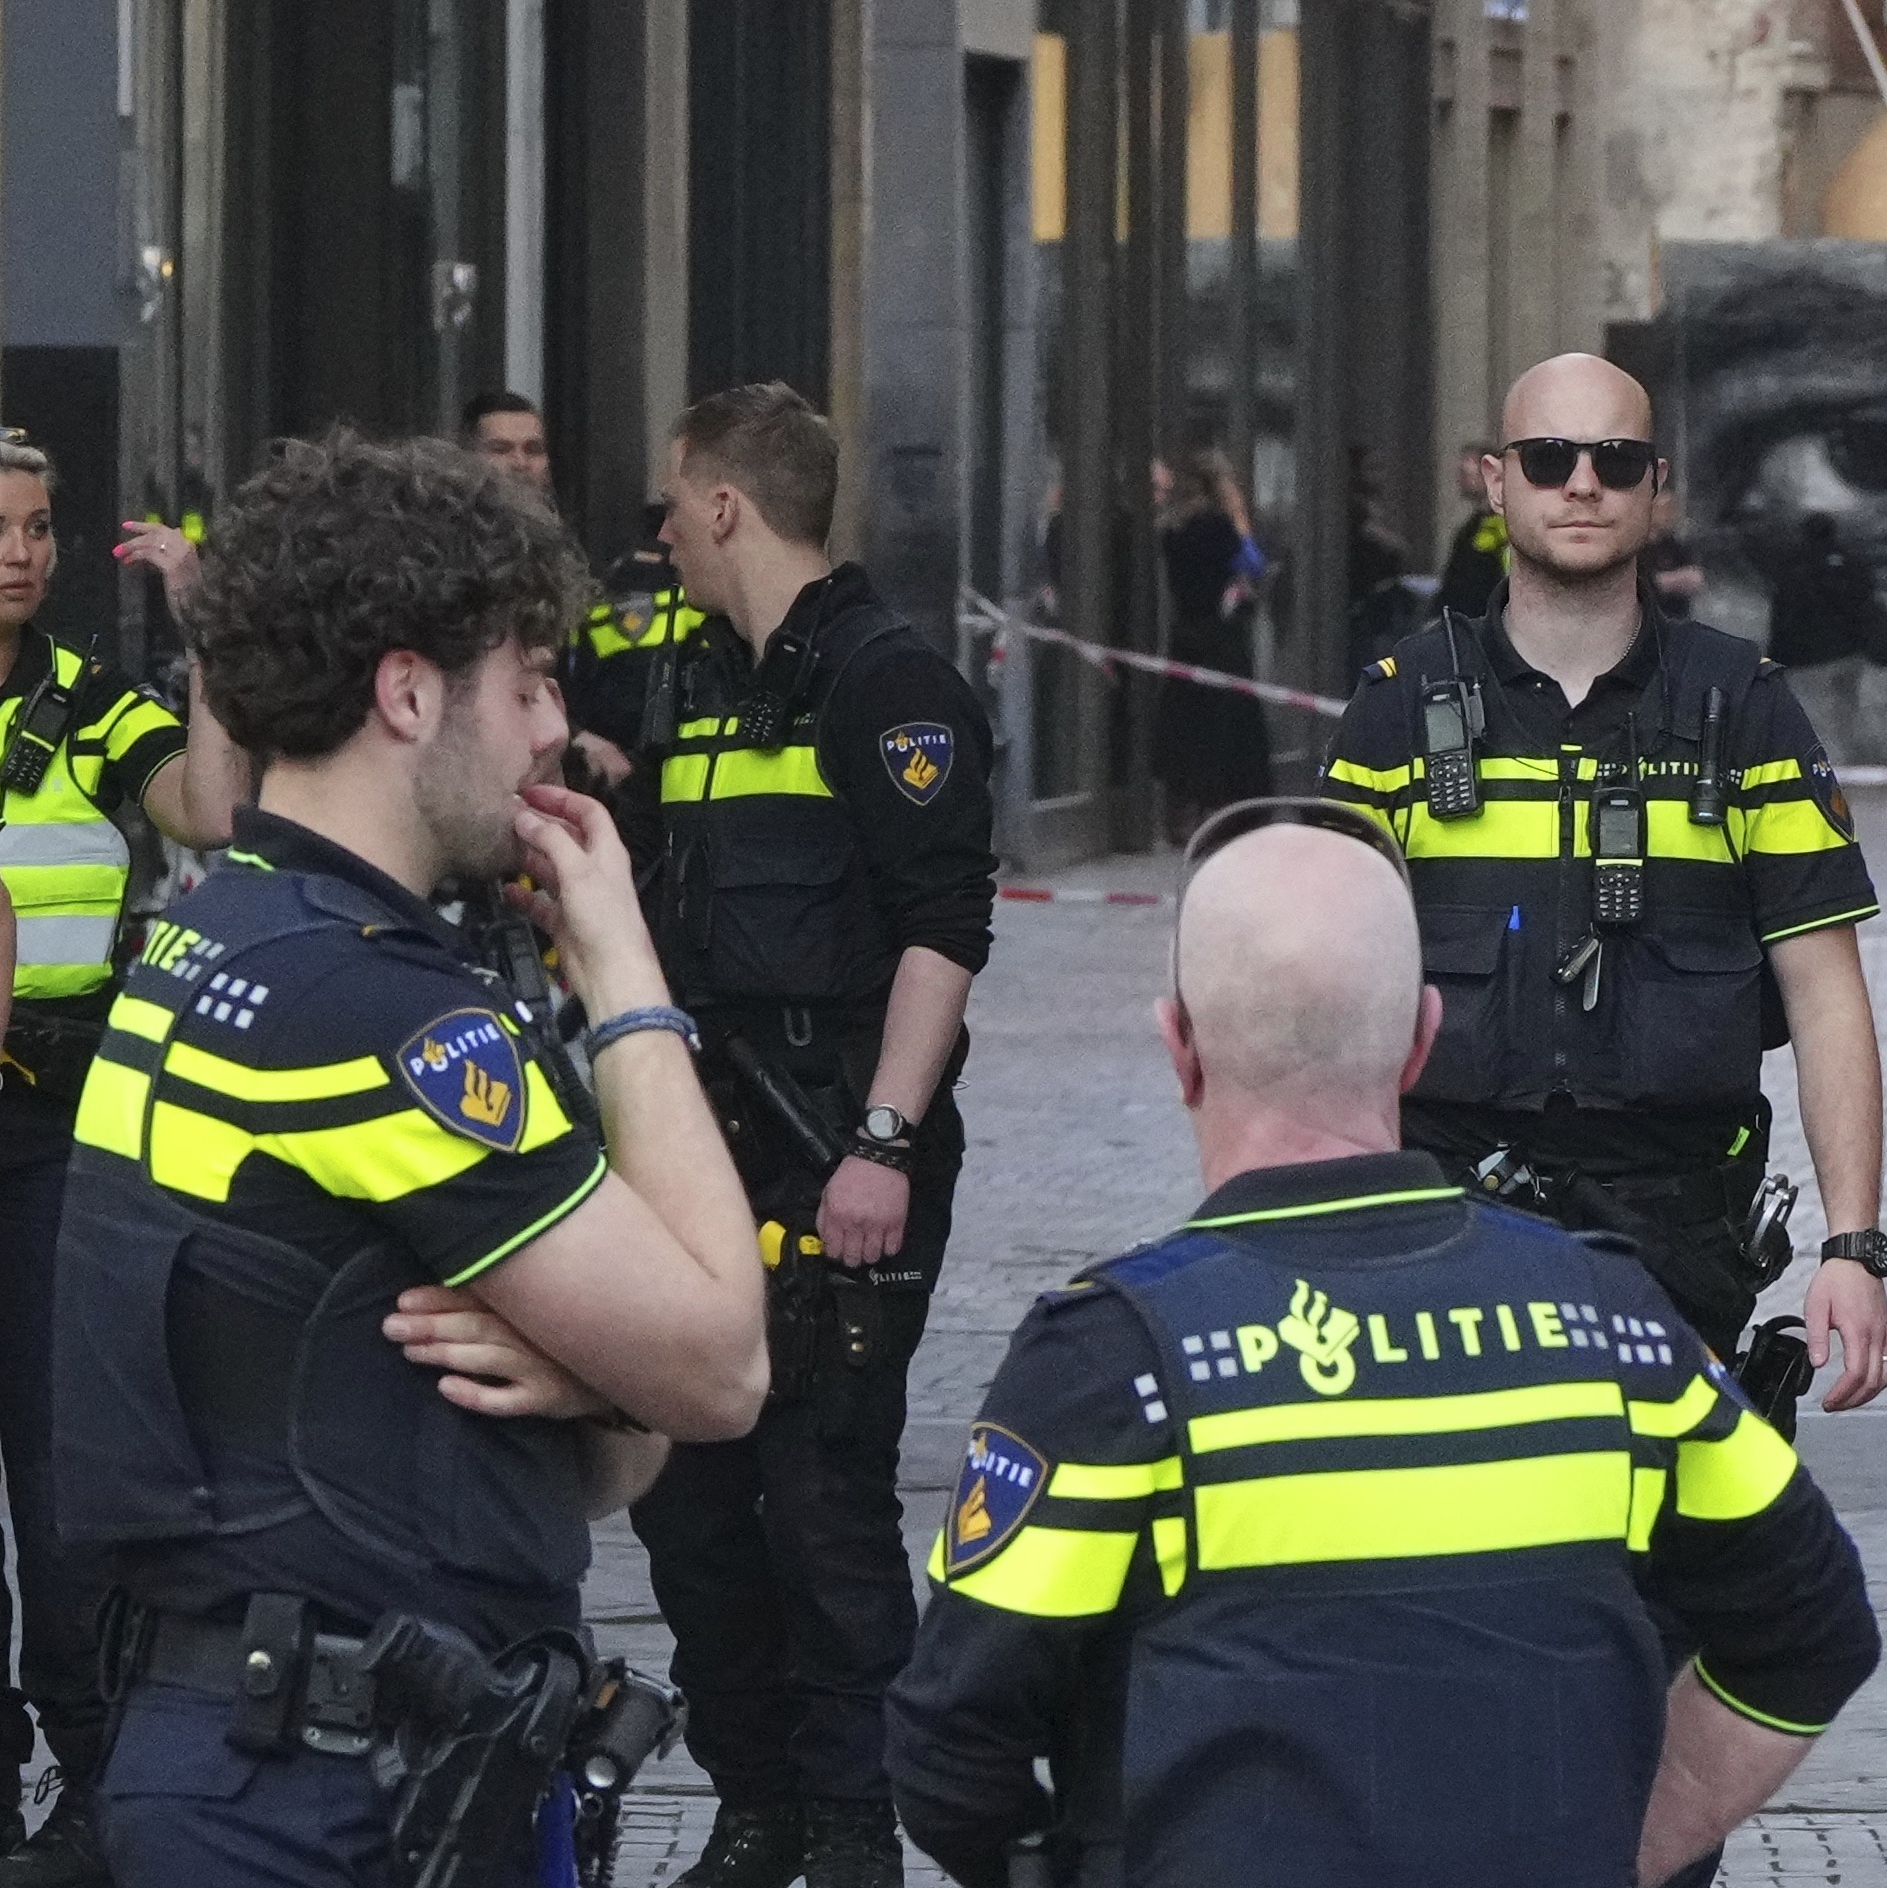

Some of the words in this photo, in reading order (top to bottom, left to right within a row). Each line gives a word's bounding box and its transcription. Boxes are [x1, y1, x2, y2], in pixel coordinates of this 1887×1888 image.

[886, 733, 947, 752] POLITIE
[410, 1023, 501, 1076] POLITIE
[1236, 1287, 1569, 1396] POLITIE
